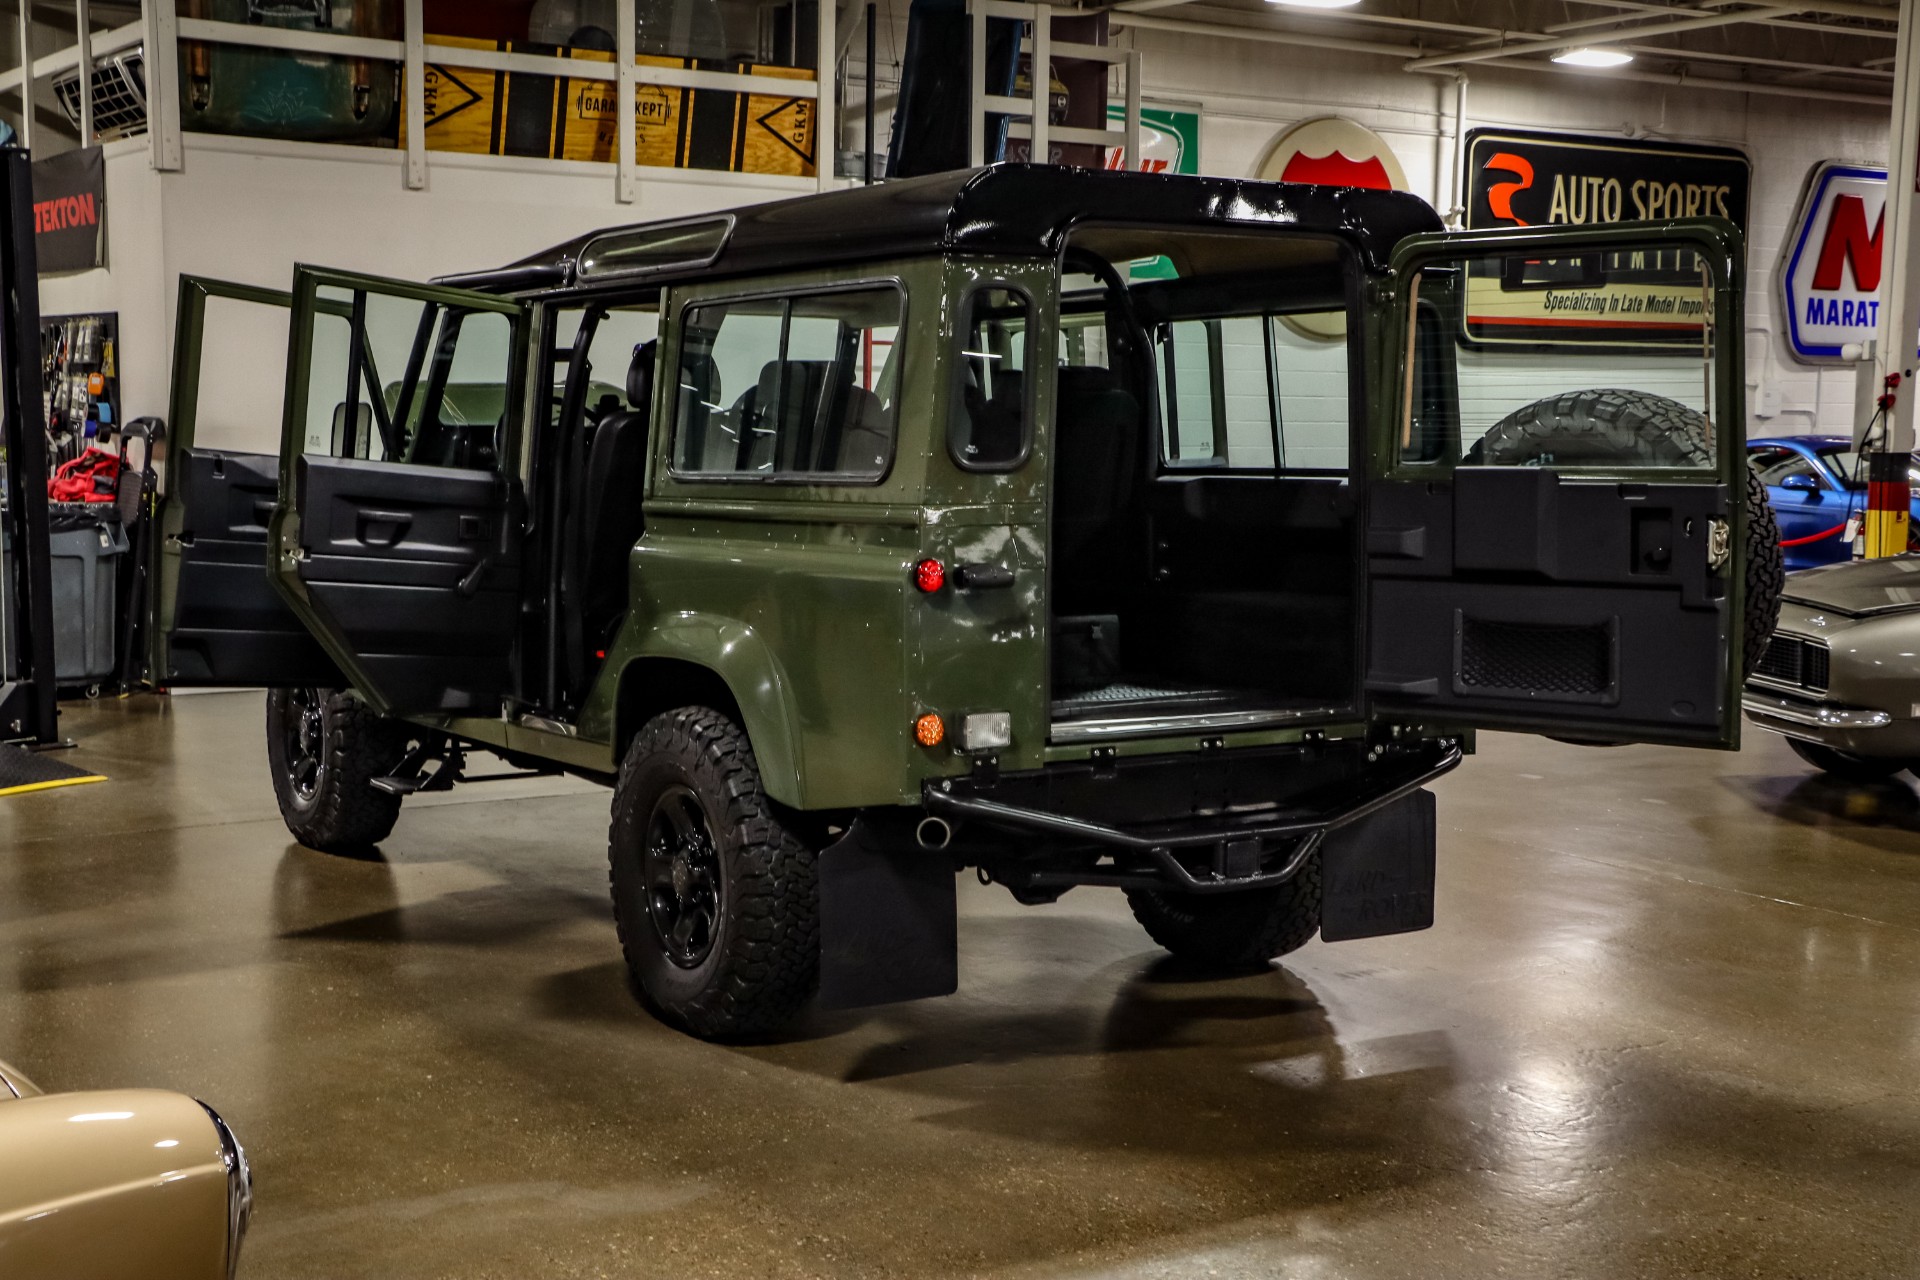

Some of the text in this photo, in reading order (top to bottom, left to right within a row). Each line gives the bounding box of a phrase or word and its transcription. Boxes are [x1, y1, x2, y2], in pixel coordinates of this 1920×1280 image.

[424, 71, 438, 117] GKM
[585, 97, 664, 117] GARA KEPT
[793, 102, 807, 144] GKM
[33, 192, 96, 234] TEKTON
[1549, 174, 1730, 224] AUTO SPORTS
[1544, 290, 1715, 317] Specializing In Late Model Impos
[1805, 297, 1880, 327] MARAT
